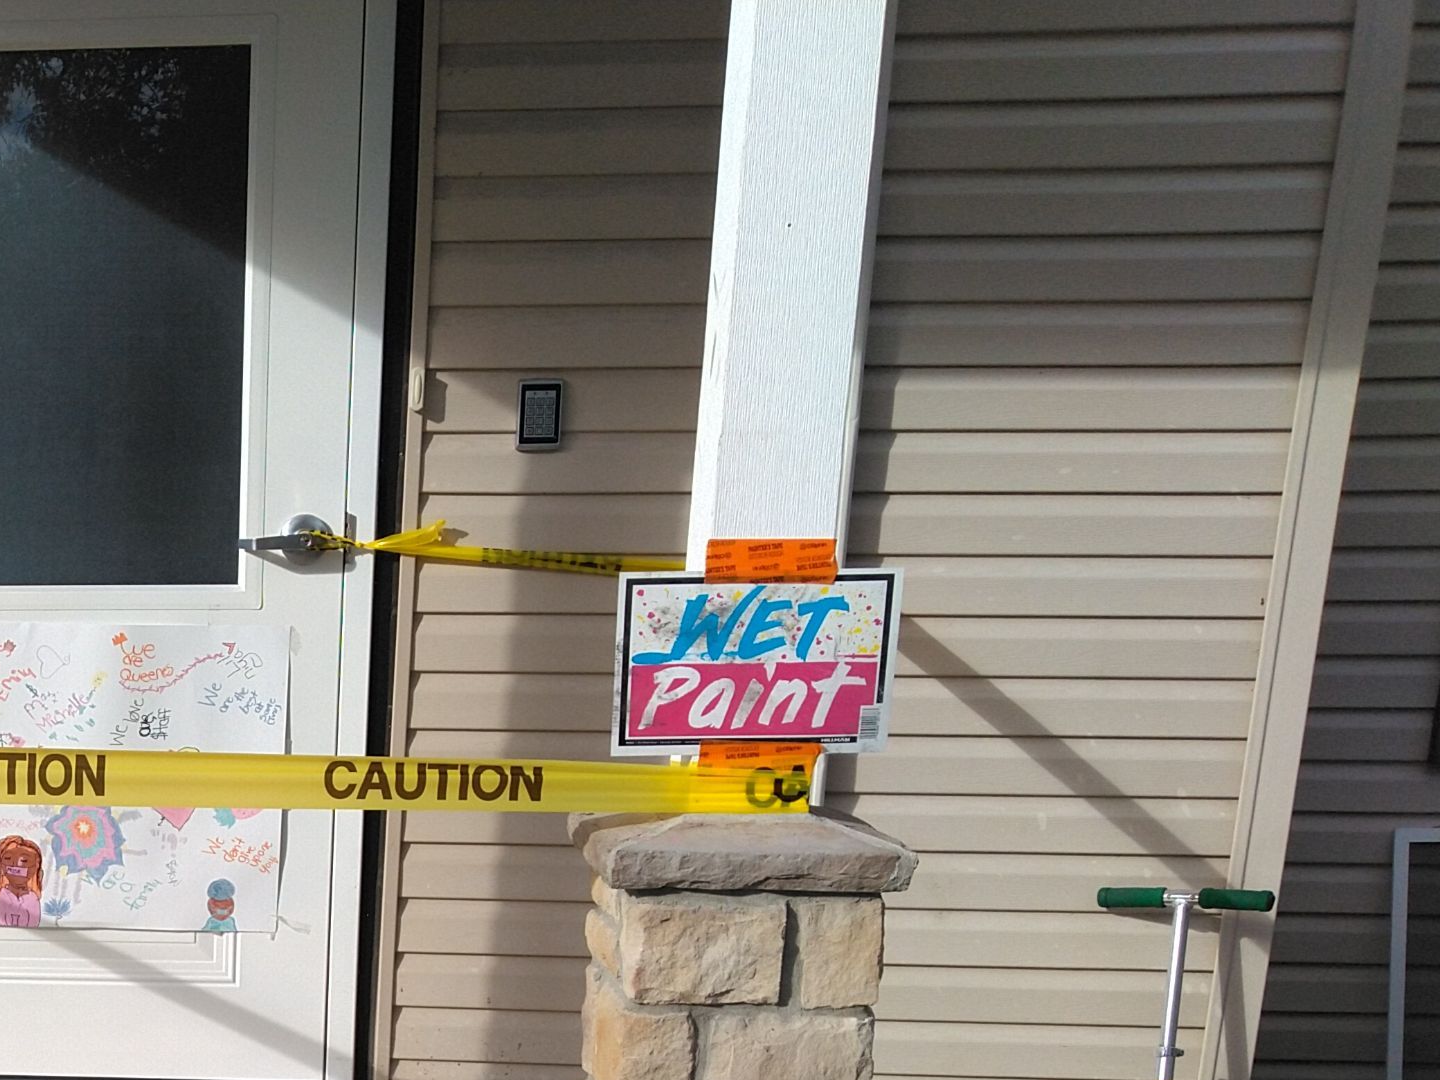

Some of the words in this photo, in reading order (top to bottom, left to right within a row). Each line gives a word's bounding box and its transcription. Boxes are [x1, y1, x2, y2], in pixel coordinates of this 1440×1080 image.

[631, 584, 850, 664] WET
[198, 682, 223, 707] We
[637, 662, 866, 730] Paint
[324, 760, 543, 802] CAUTION
